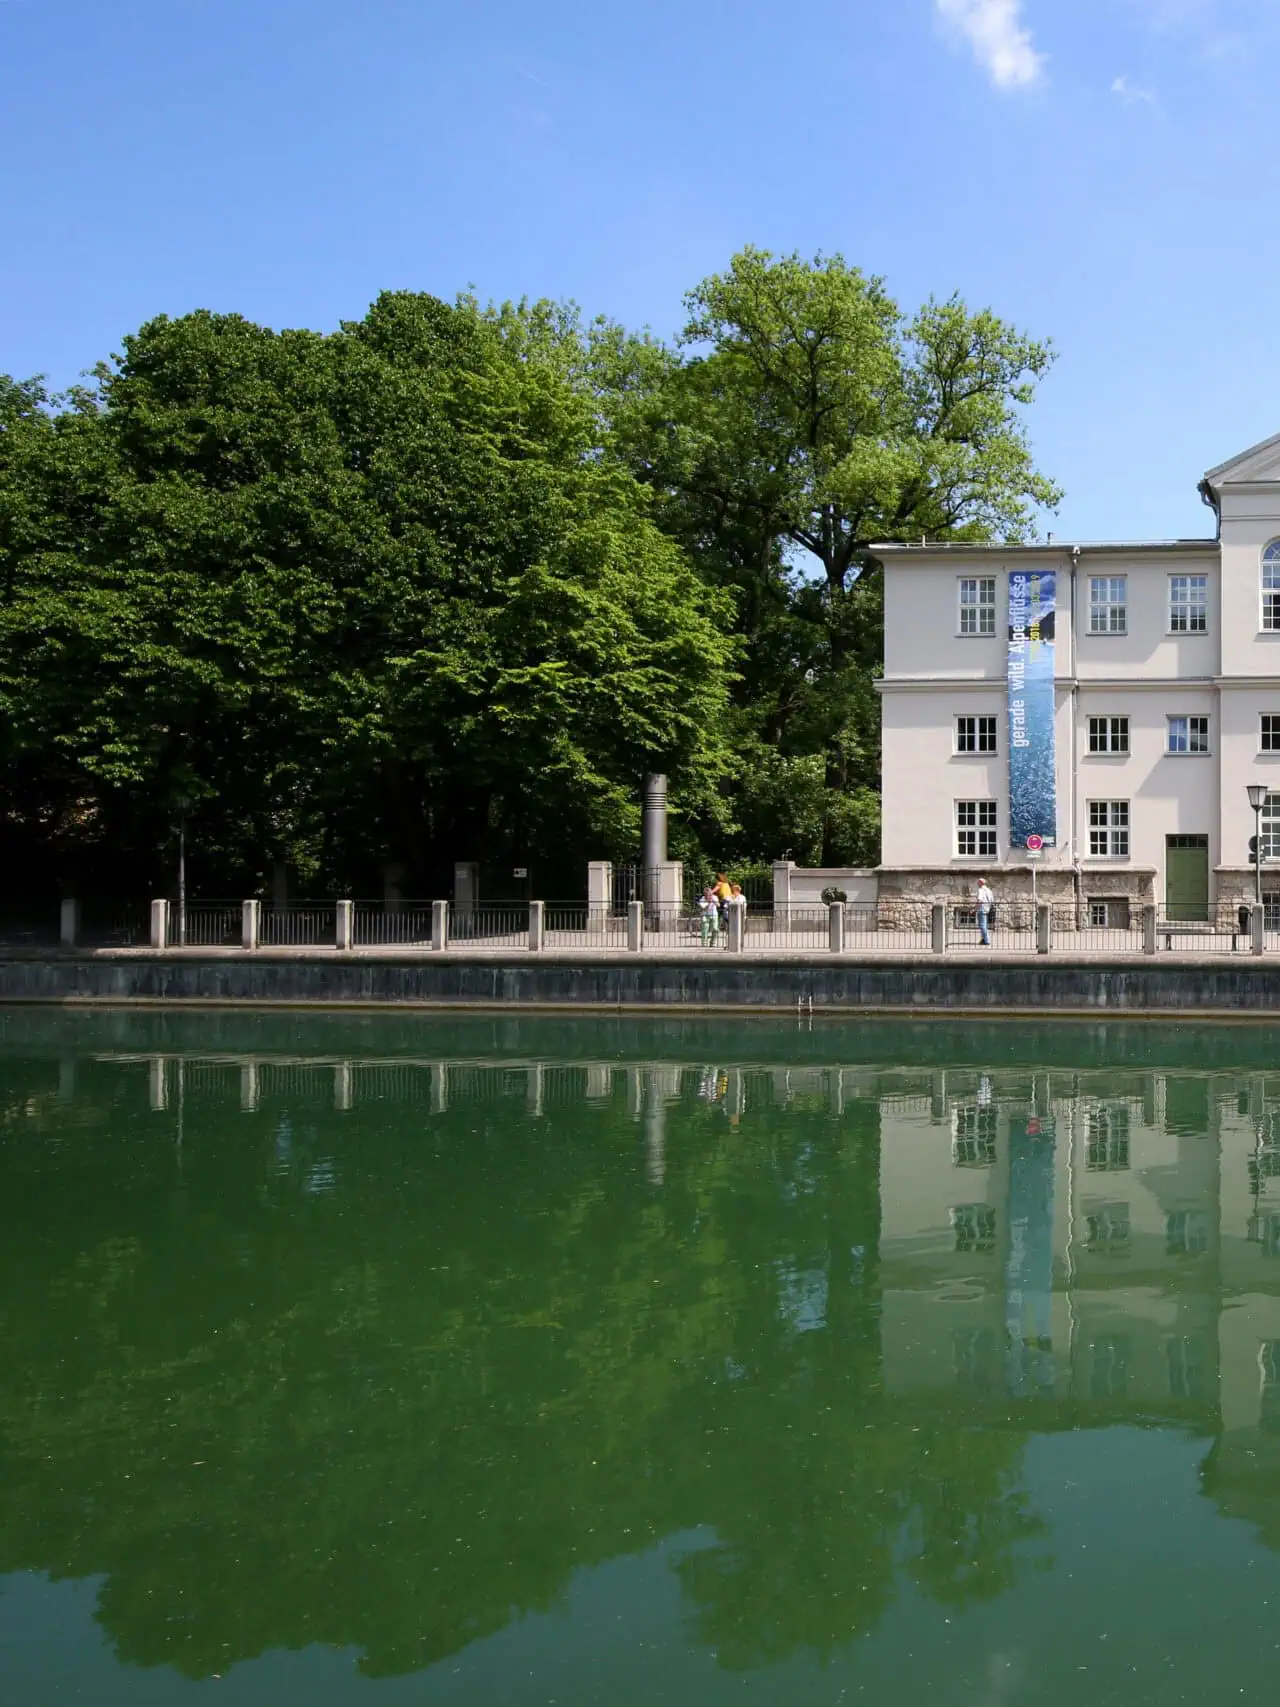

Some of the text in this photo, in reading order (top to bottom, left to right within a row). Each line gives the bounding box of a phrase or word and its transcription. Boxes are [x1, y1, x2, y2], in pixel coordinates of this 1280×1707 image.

[1007, 575, 1030, 748] gerade wild. Alpenflüsse
